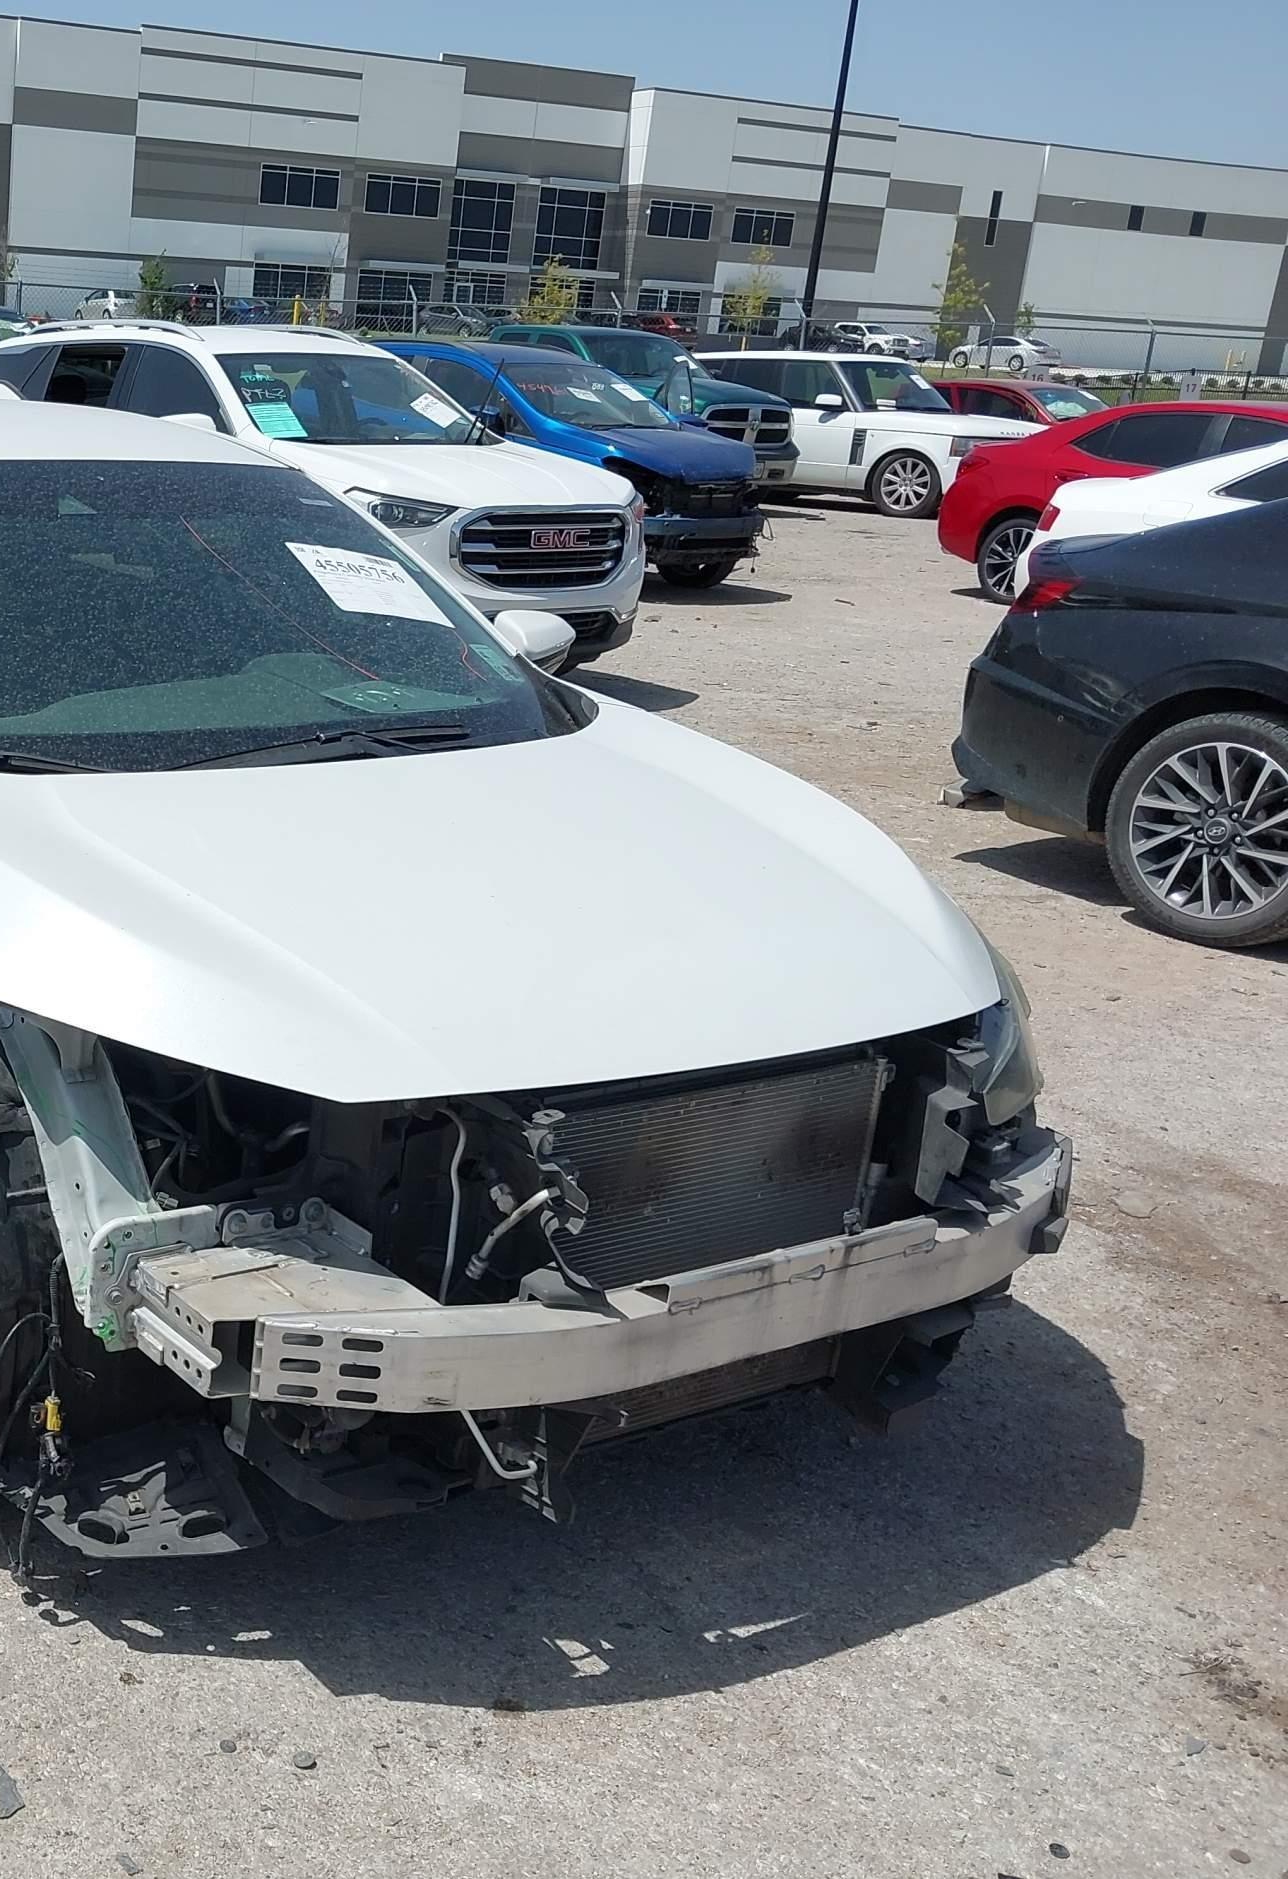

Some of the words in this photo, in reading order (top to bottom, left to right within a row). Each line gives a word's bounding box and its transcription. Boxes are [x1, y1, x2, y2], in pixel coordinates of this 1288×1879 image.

[1186, 383, 1197, 393] 17
[531, 529, 591, 549] GMC
[314, 558, 405, 584] 45505756
